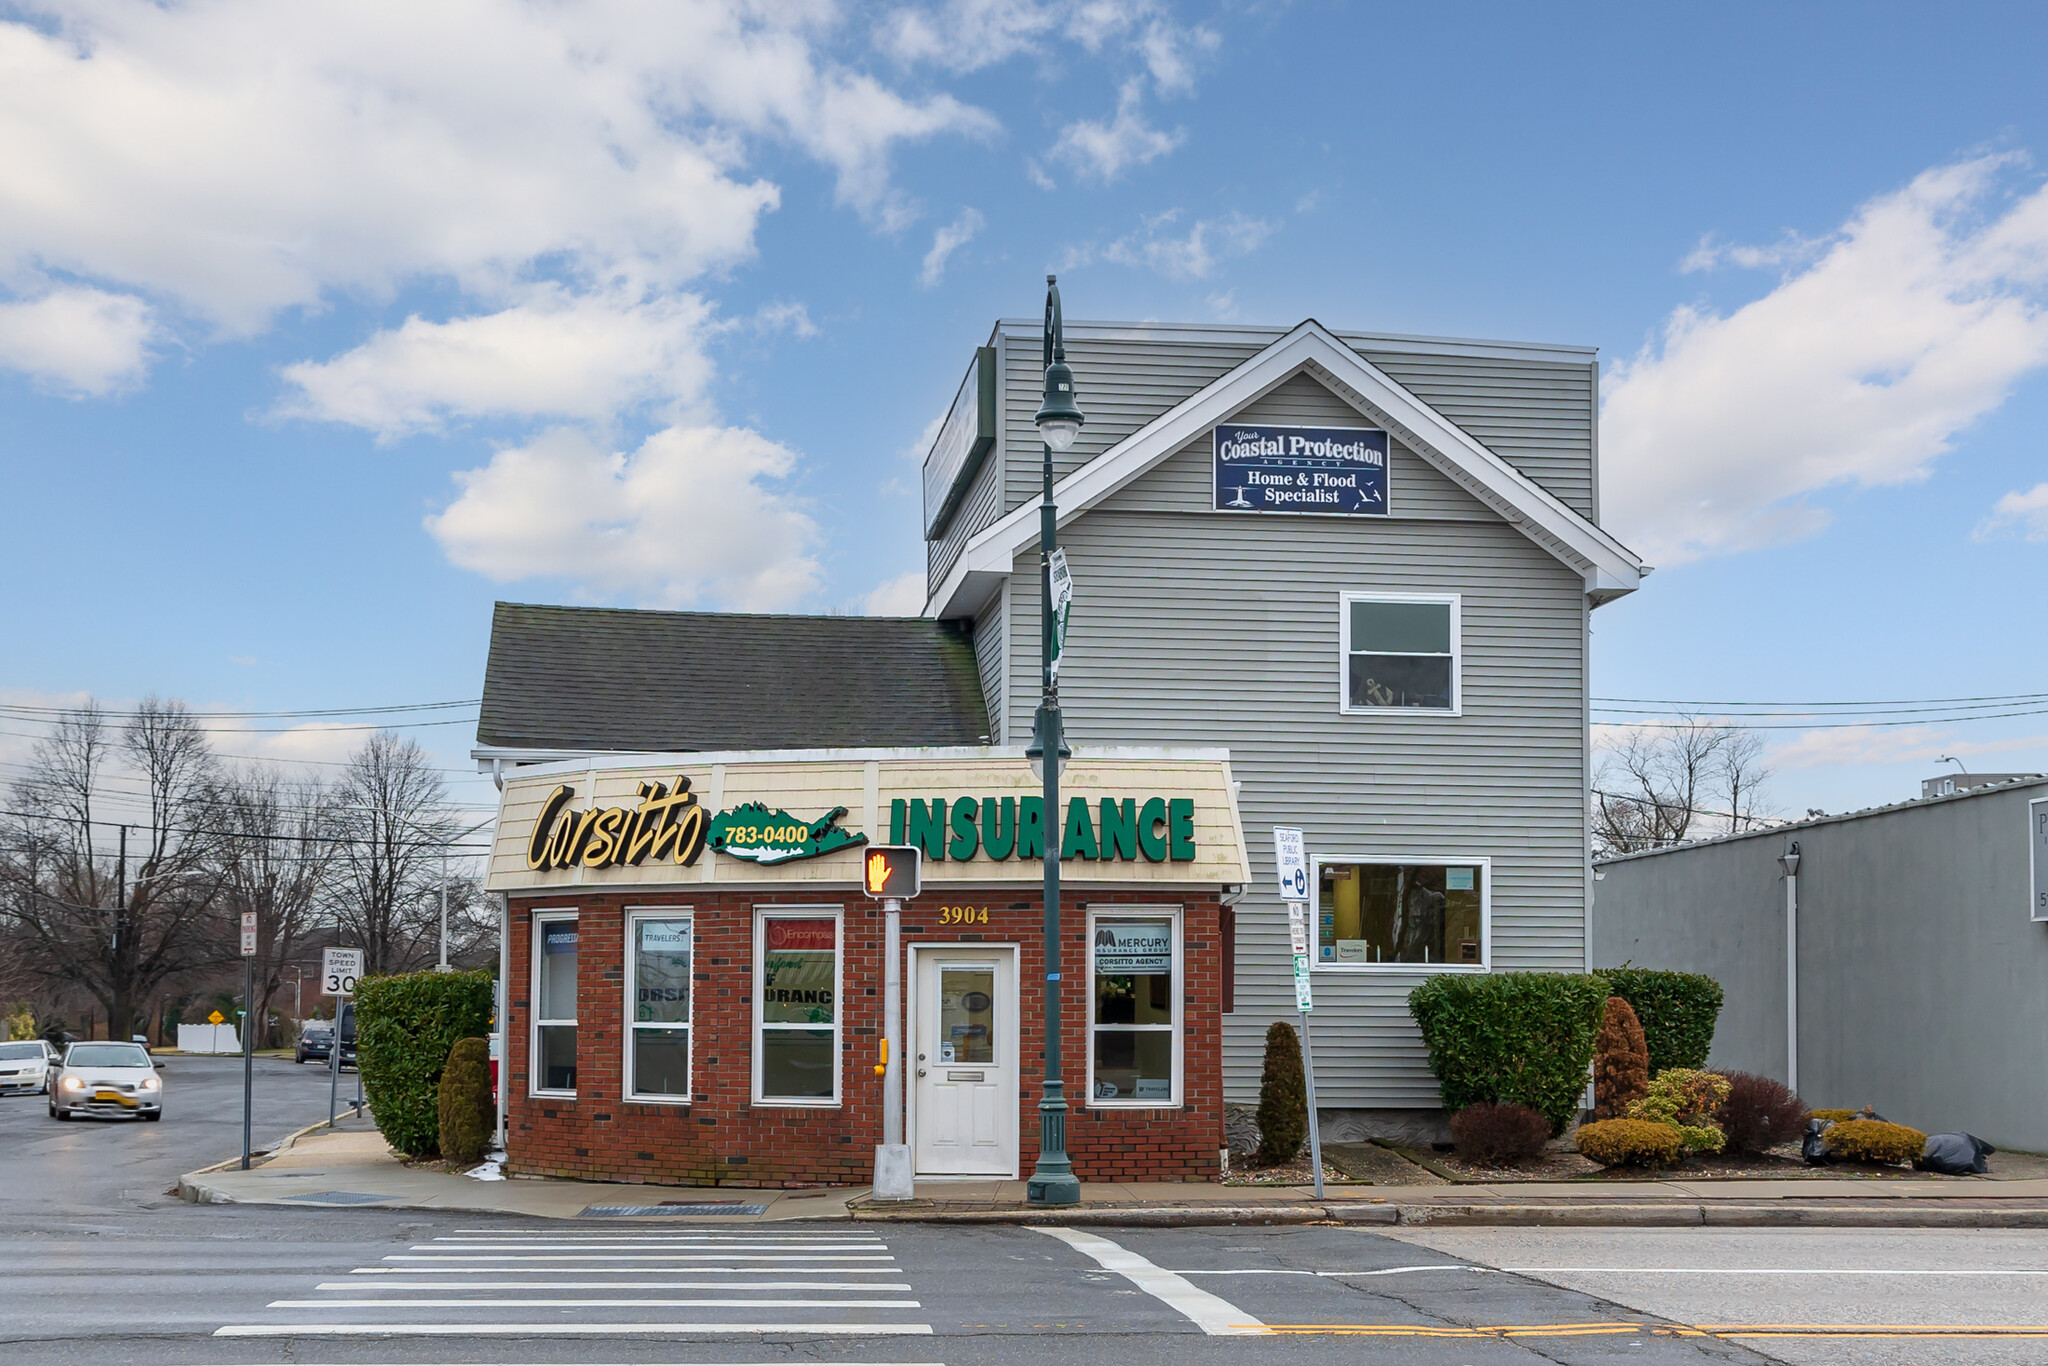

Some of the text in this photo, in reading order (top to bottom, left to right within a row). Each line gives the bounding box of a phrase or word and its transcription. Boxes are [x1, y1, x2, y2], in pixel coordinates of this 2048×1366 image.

[1234, 430, 1260, 444] Your
[1220, 435, 1384, 467] Coastal Protection
[1262, 459, 1341, 467] AGENCY
[1247, 471, 1357, 488] Home & Flood
[1264, 488, 1340, 505] Specialist
[526, 774, 711, 872] Corsitto
[889, 796, 1196, 862] INSURANCE
[724, 825, 809, 845] 783-0400
[1279, 832, 1299, 843] SEAFORD
[1282, 845, 1299, 855] PUBLIC
[1282, 857, 1300, 866] LIBRARY
[938, 906, 990, 925] 3904
[645, 934, 681, 943] TRAVELERS
[786, 929, 834, 941] Encompas
[1118, 938, 1169, 948] MERCURY
[328, 959, 356, 967] SPEED
[326, 974, 356, 992] 30
